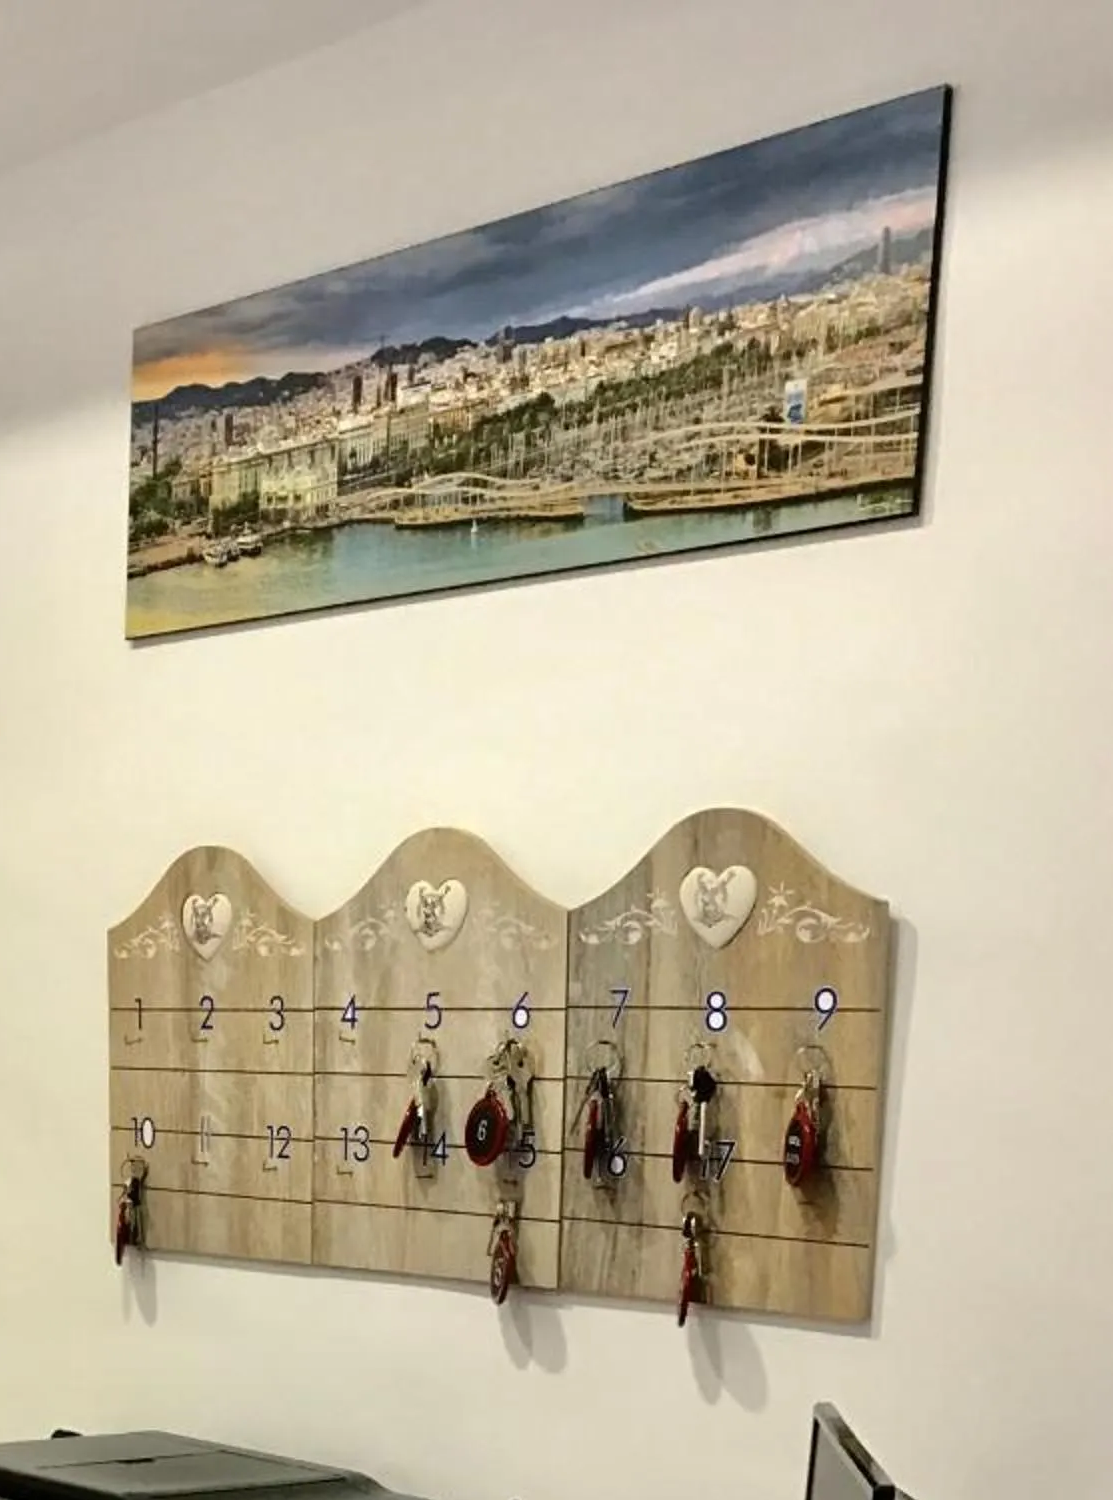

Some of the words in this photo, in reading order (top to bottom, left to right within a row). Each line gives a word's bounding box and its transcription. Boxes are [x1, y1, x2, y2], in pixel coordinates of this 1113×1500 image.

[135, 998, 142, 1030] 1
[199, 995, 214, 1030] 2
[269, 995, 285, 1031] 3
[340, 994, 358, 1030] 4
[424, 992, 442, 1029] 5
[512, 992, 530, 1029] 6
[609, 989, 630, 1029] 7
[705, 991, 728, 1031] 8
[814, 987, 838, 1031] 9
[131, 1117, 155, 1149] 10
[200, 1115, 211, 1153] 11
[266, 1125, 292, 1159] 12
[340, 1125, 370, 1163] 13
[476, 1119, 488, 1141] 6
